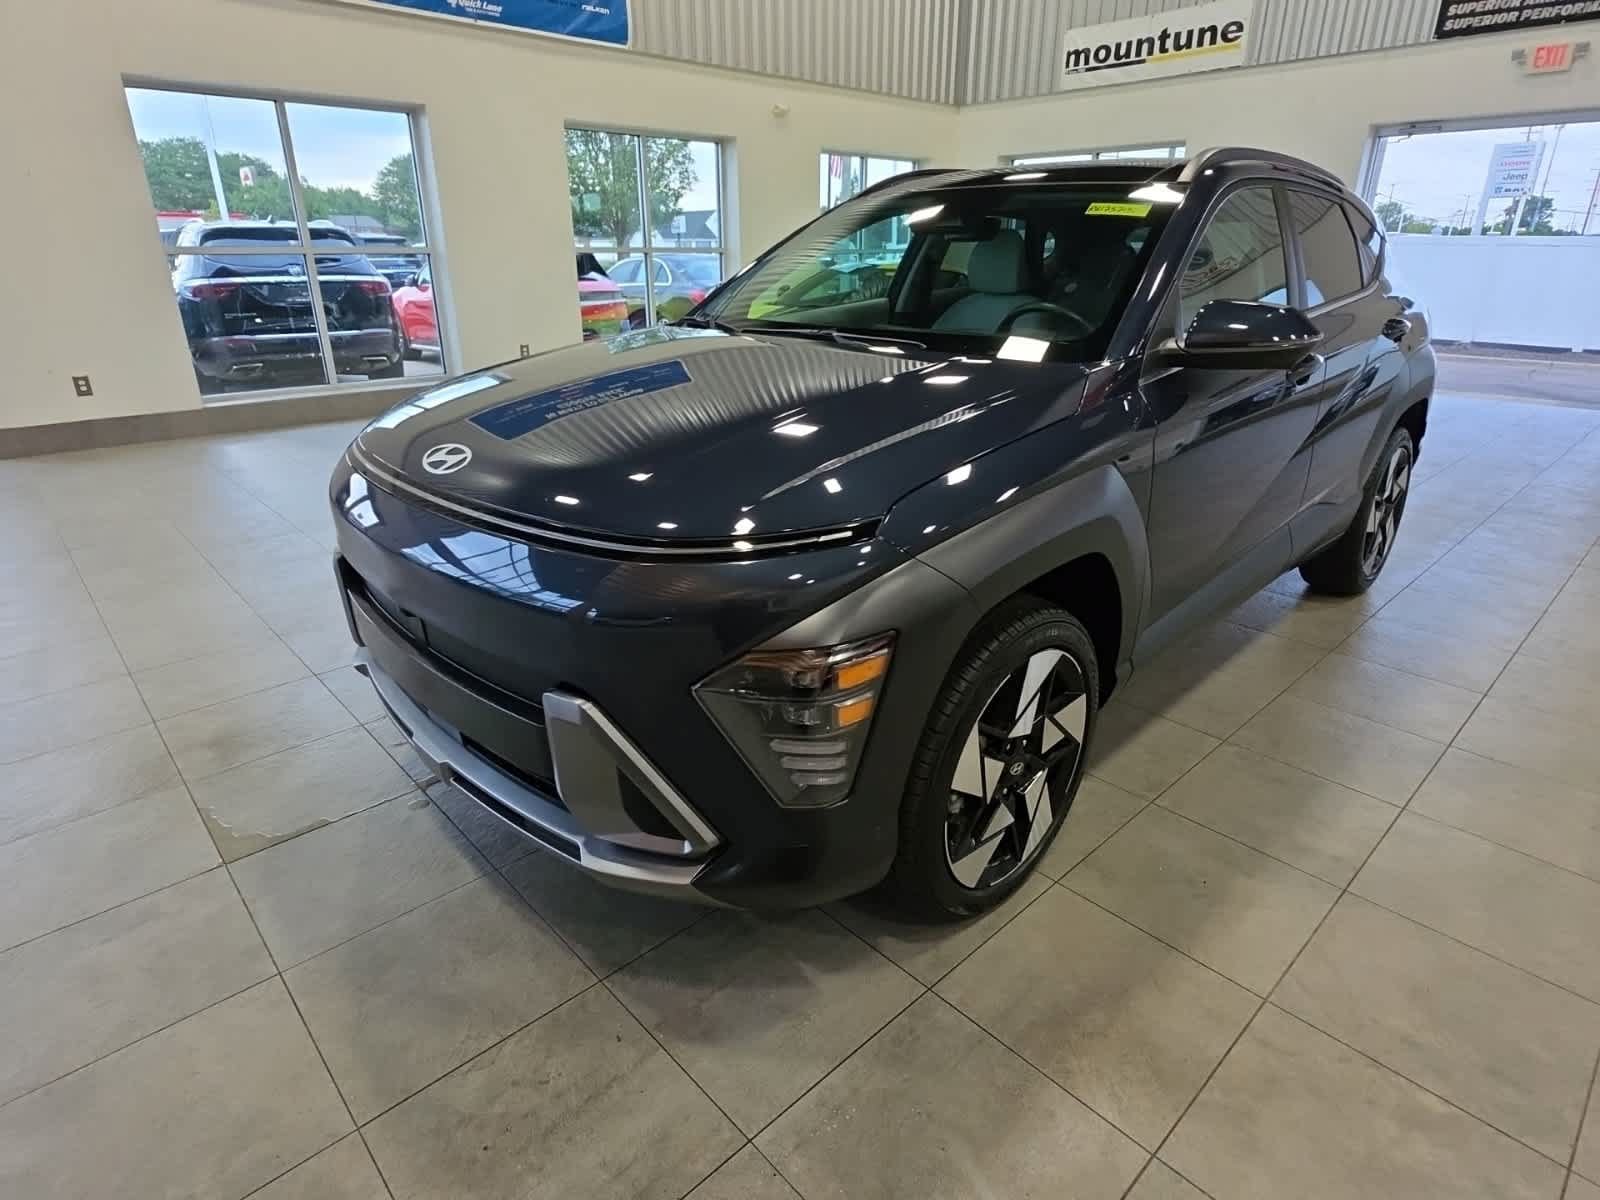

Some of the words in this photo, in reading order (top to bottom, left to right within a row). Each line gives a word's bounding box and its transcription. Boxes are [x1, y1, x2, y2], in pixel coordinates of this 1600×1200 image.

[1448, 0, 1520, 15] SUPERIOR
[1443, 11, 1519, 30] SUPERIOR
[1065, 20, 1243, 68] mountune
[1534, 44, 1568, 68] EXIT
